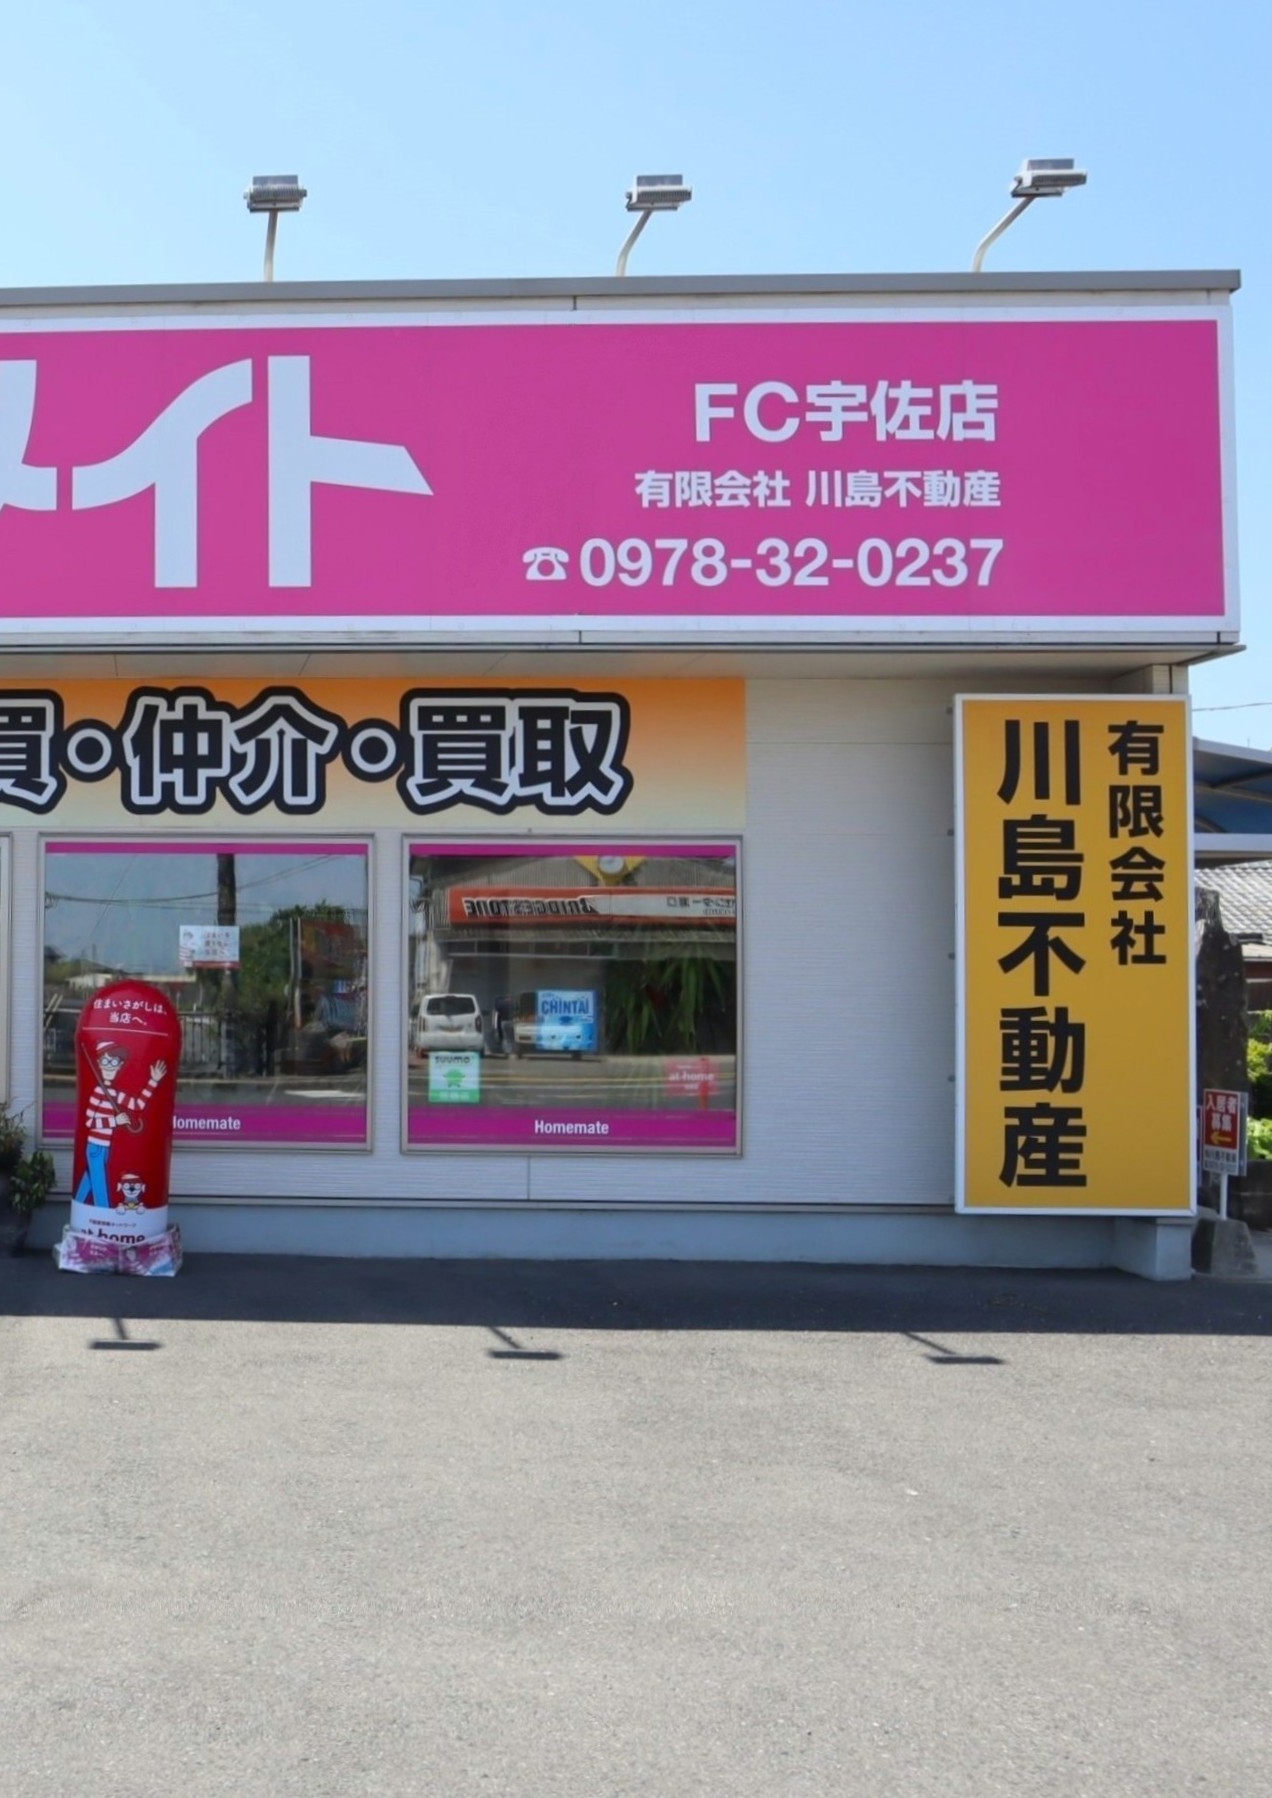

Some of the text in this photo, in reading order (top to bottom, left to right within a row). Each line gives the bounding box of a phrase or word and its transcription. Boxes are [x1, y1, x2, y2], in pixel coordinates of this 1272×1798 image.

[694, 379, 999, 443] FC宇佐店
[634, 469, 1001, 508] 有限会社 川島不動産
[580, 538, 1004, 587] 0978-32-0237
[1107, 720, 1167, 966] 有限会社
[996, 719, 1088, 1188] 川島不動産
[108, 1011, 149, 1027] 当店へ。
[534, 1119, 610, 1135] Homemate
